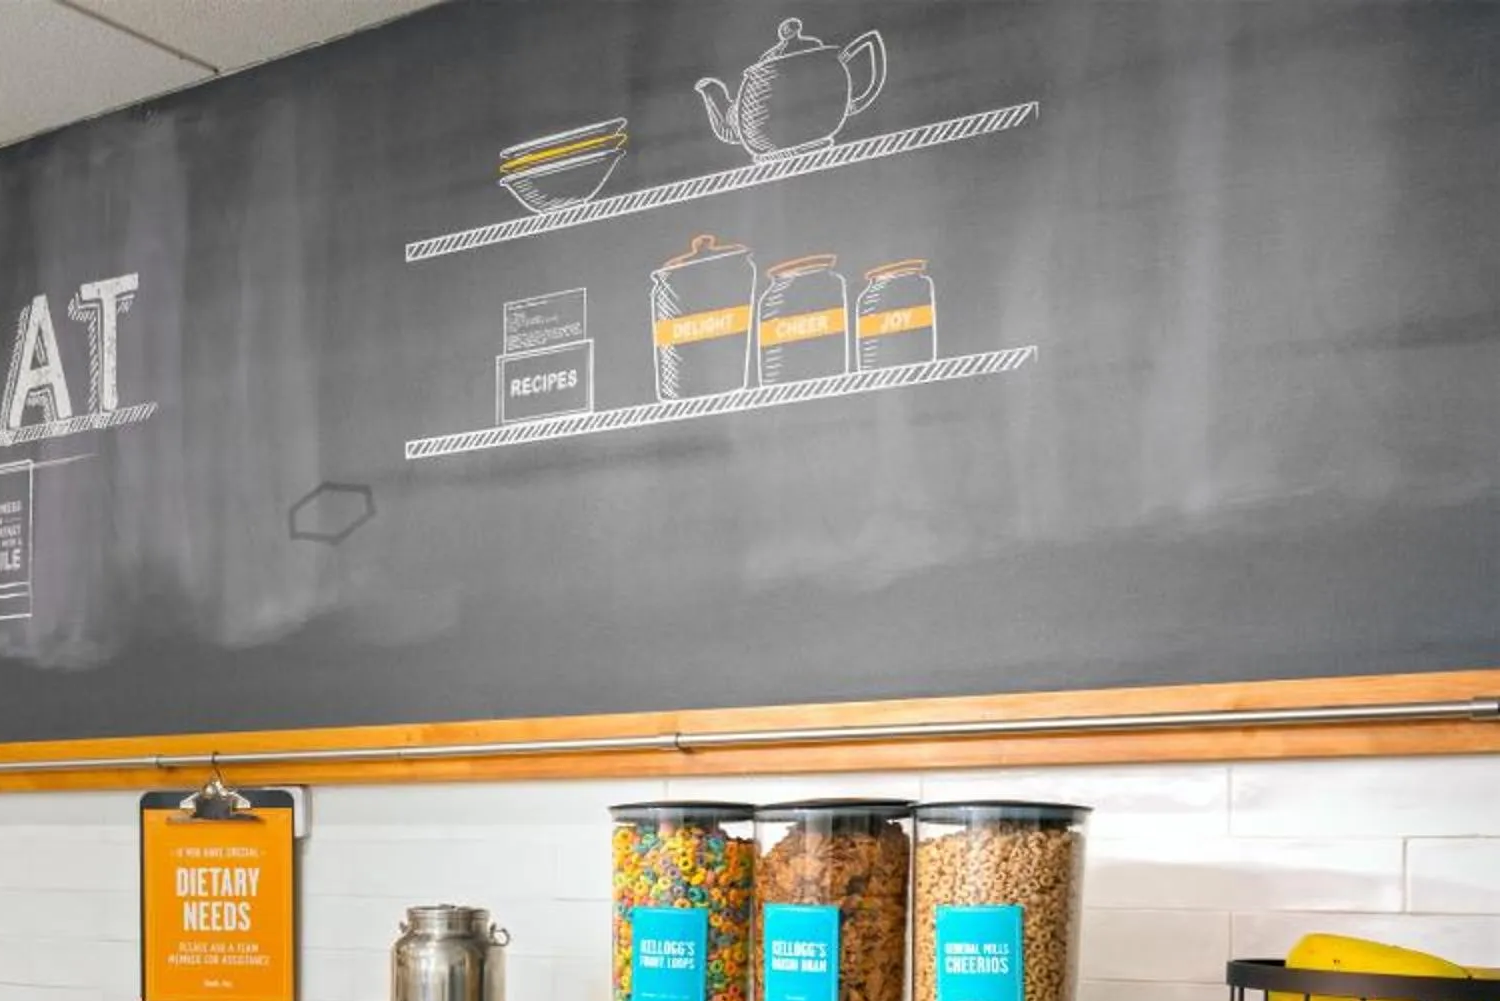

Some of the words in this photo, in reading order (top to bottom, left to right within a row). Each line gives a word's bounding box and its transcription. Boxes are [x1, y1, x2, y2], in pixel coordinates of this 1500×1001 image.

[673, 313, 733, 339] DELIGHT
[776, 315, 828, 337] CHEER
[879, 311, 912, 335] JOY
[510, 369, 578, 398] RECIPES
[175, 866, 260, 898] DIETARY
[183, 901, 251, 932] NEEDS
[640, 939, 696, 957] KELLOGG'S
[771, 940, 829, 958] KELLOGG'S
[983, 943, 1010, 955] MILLS
[667, 956, 696, 971] LOOPS
[944, 955, 1010, 975] CHEERIOS
